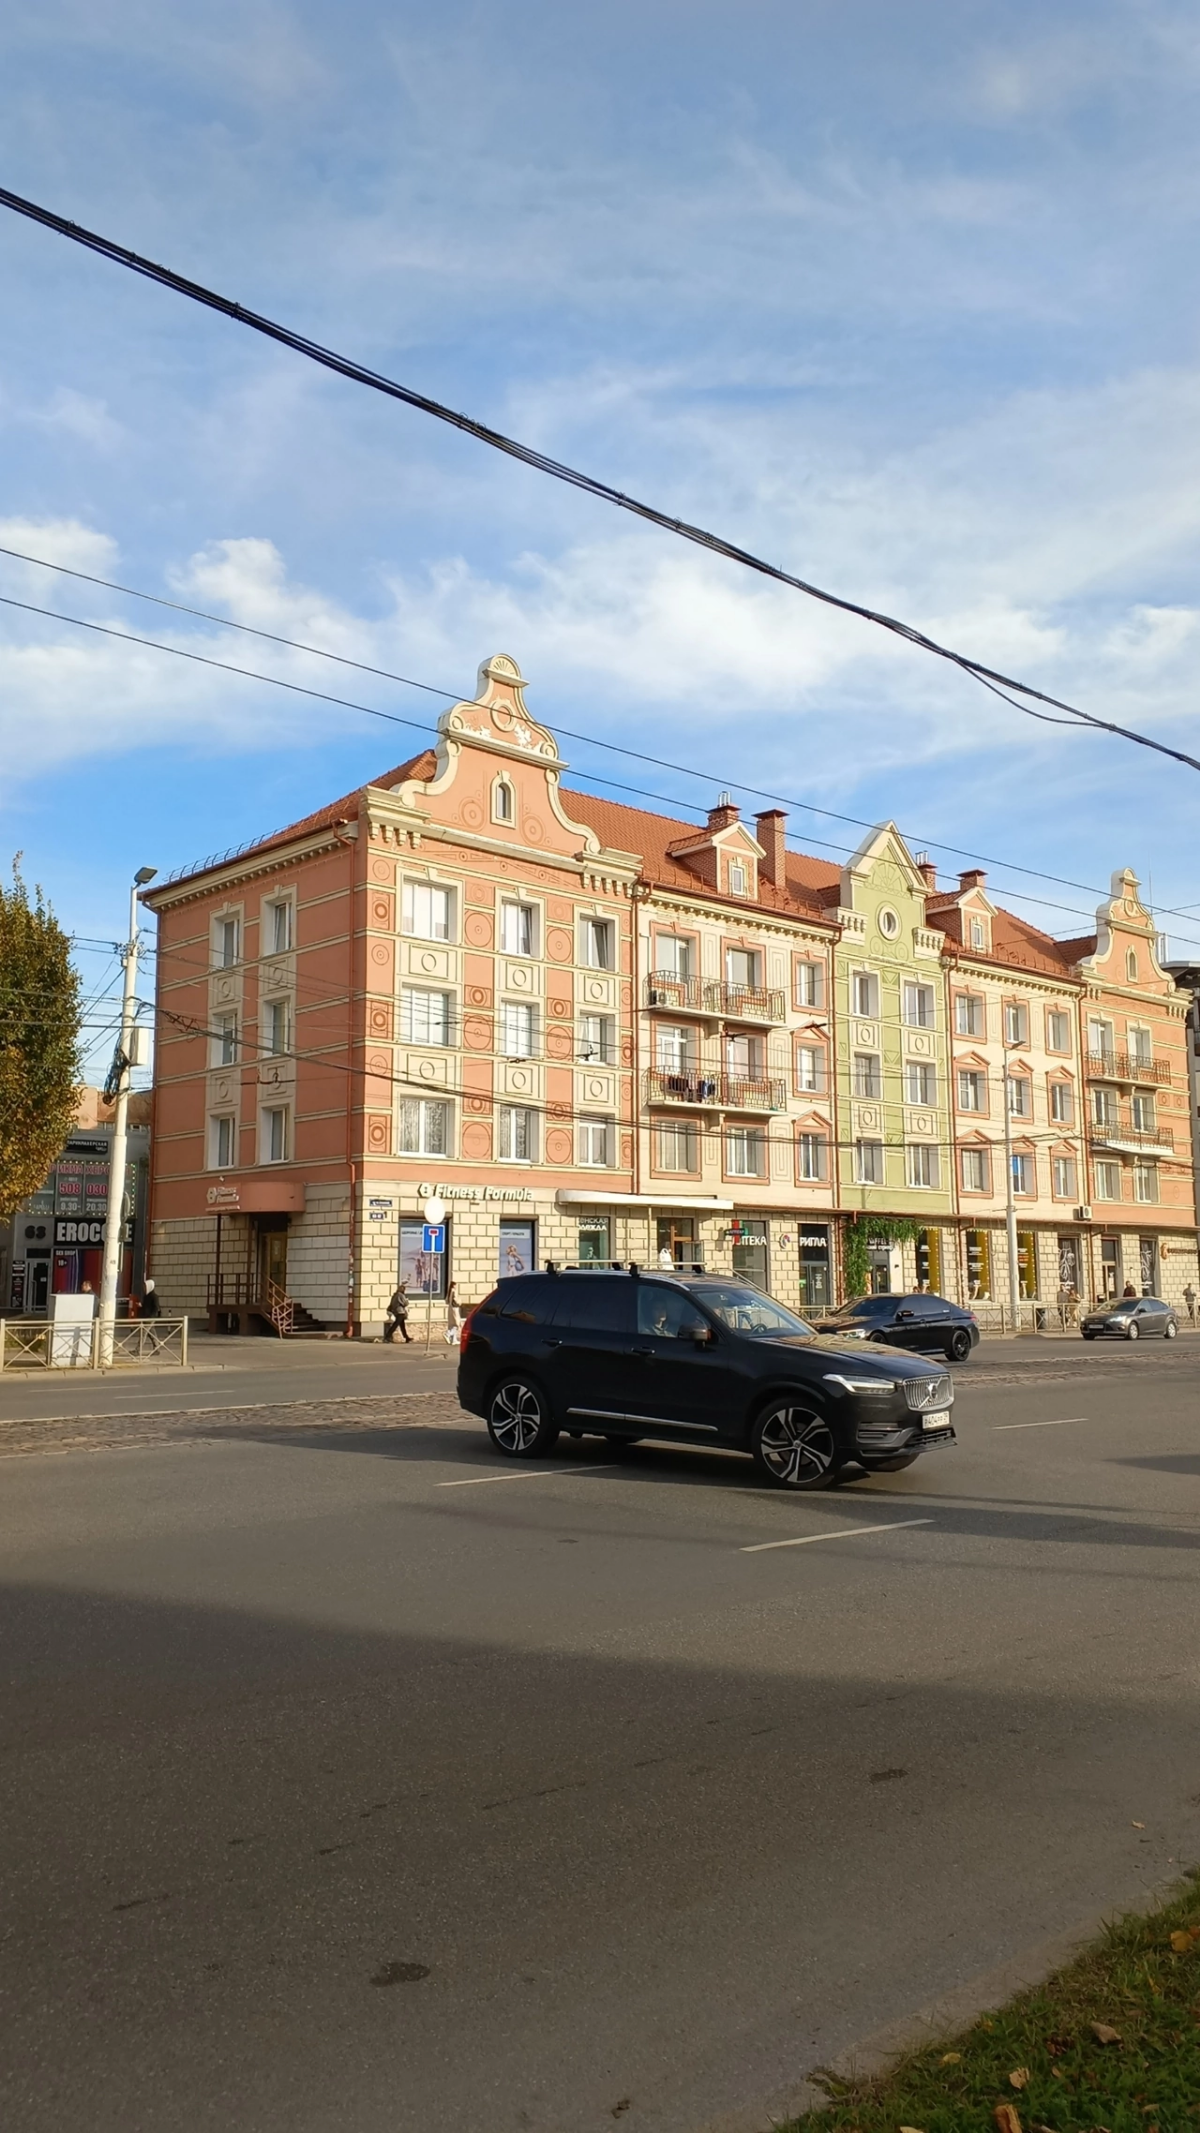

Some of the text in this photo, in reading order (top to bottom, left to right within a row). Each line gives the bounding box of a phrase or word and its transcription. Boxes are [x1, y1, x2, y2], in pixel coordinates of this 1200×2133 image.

[60, 1182, 107, 1195] 508 030
[435, 1184, 534, 1202] Fitness Formula
[86, 1203, 107, 1212] 20.30
[25, 1225, 47, 1239] 63
[56, 1222, 133, 1242] EROCE
[799, 1236, 828, 1247] РИГЛА
